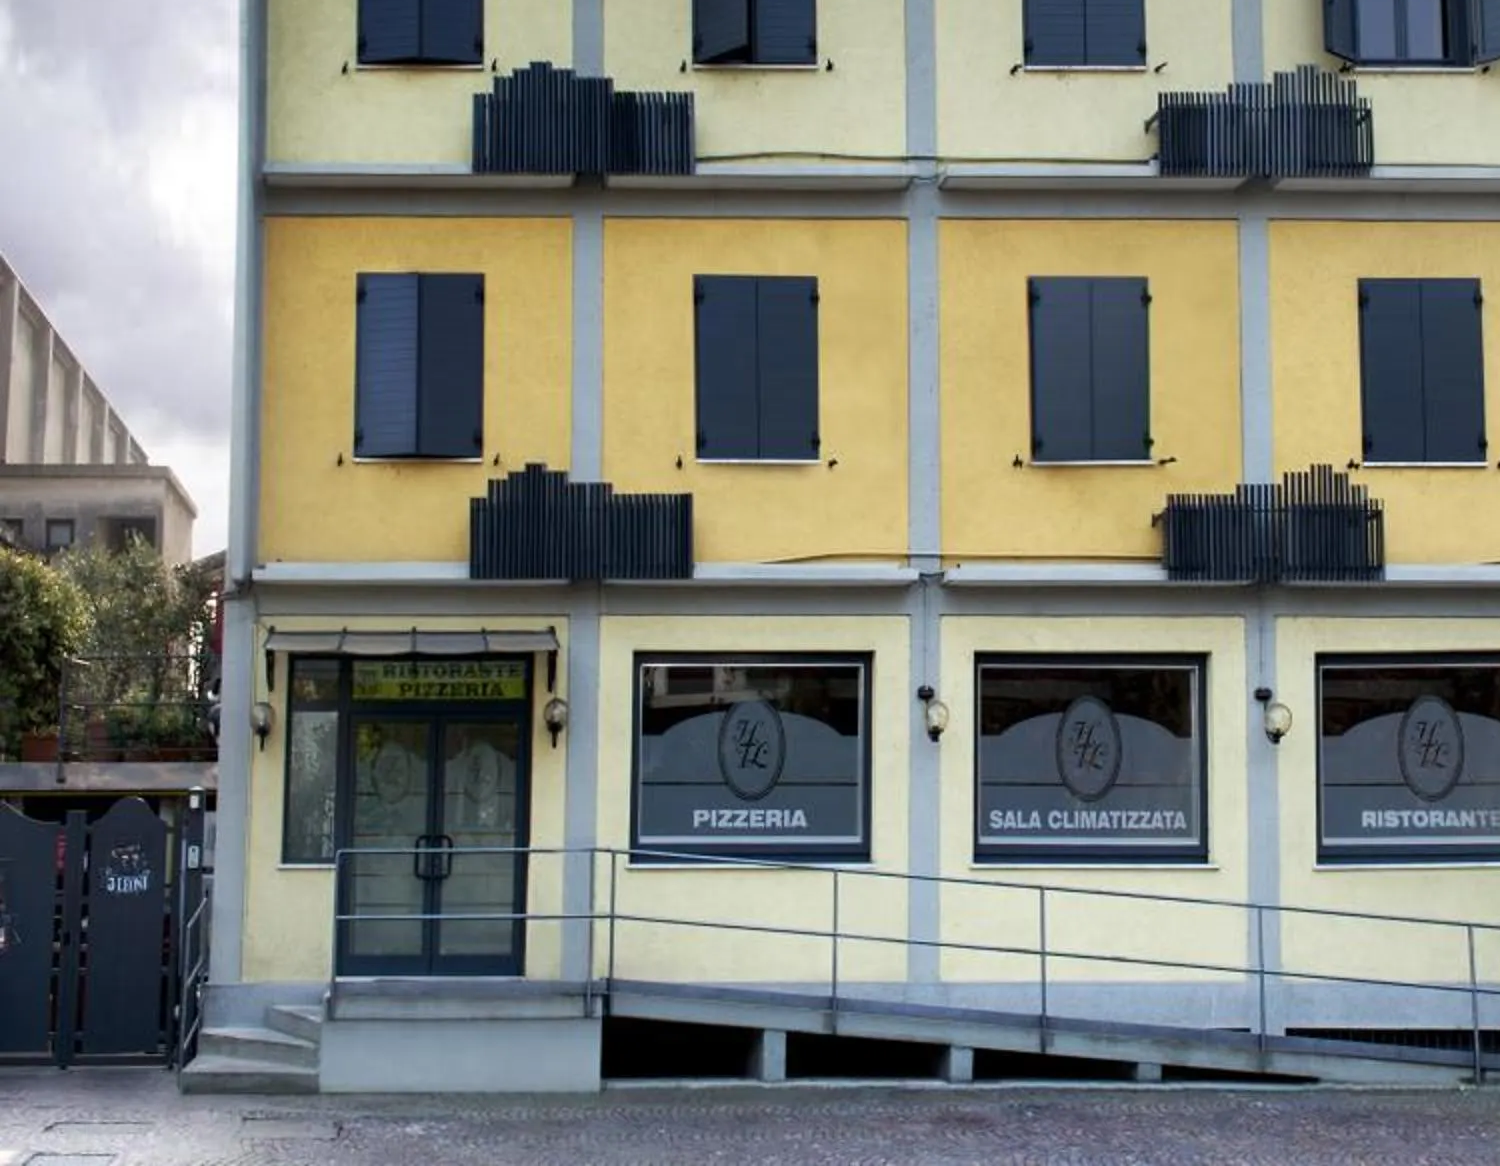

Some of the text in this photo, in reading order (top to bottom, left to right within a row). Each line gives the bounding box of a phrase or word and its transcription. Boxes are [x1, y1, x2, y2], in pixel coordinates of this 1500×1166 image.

[398, 682, 505, 698] PIZZERIA
[693, 809, 808, 828] PIZZERIA
[989, 810, 1187, 830] SALA CLIMATIZZATA
